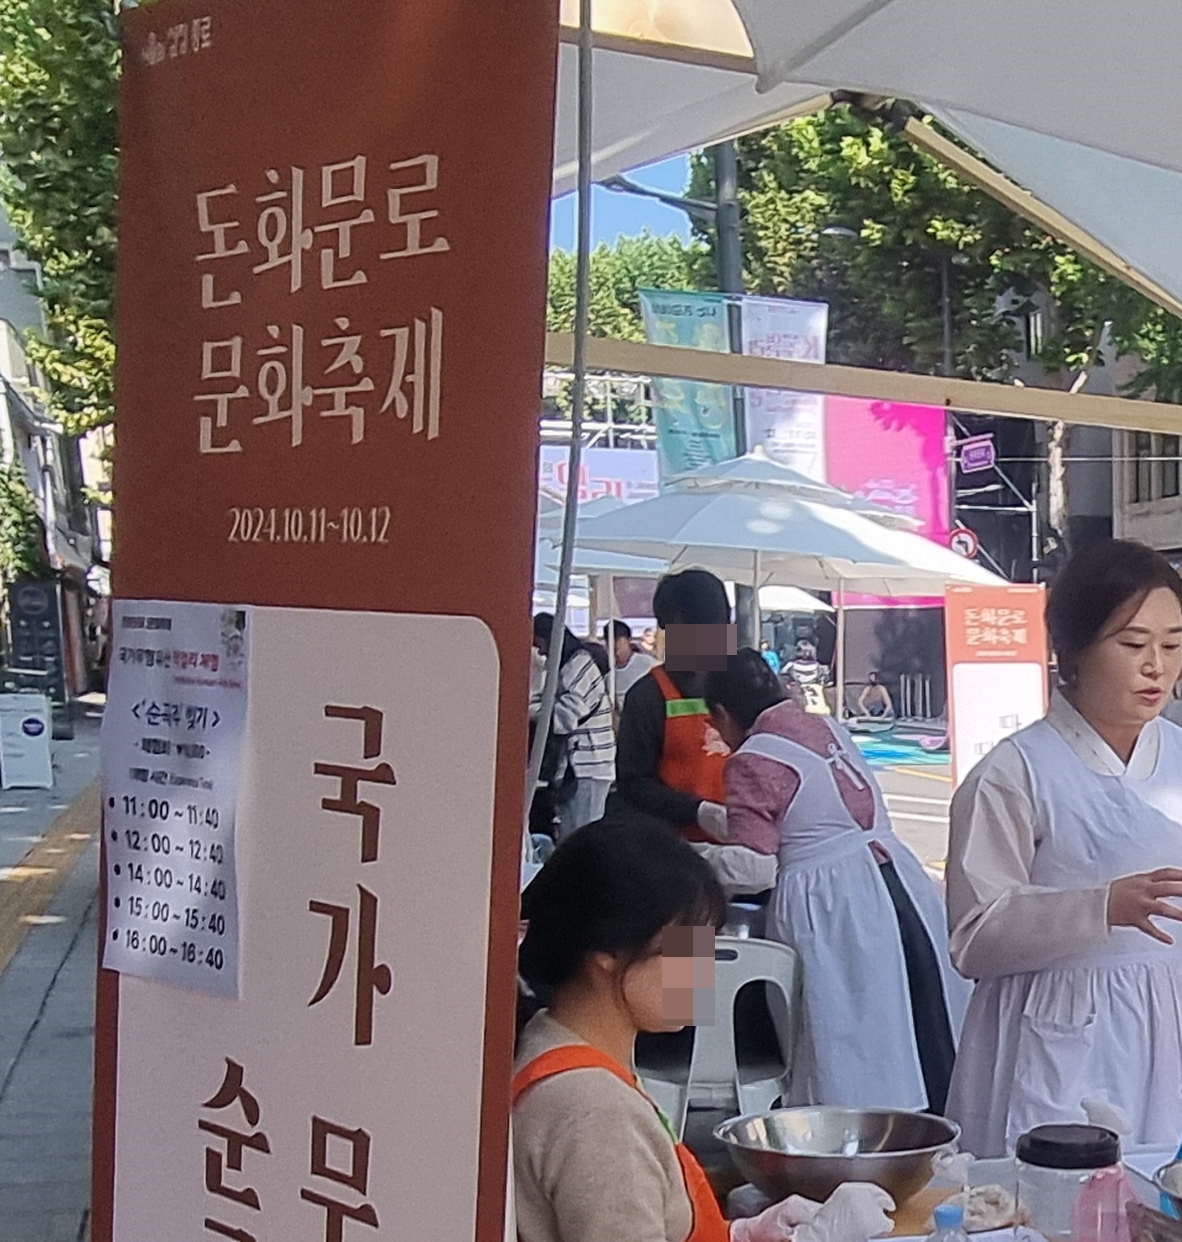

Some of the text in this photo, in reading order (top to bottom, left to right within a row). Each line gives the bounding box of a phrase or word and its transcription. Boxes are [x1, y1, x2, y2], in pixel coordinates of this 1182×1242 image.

[196, 154, 450, 308] 돈화문로
[194, 306, 443, 453] 문화축제
[227, 506, 391, 543] 2024.10.11~10.12
[307, 705, 397, 1046] 국가
